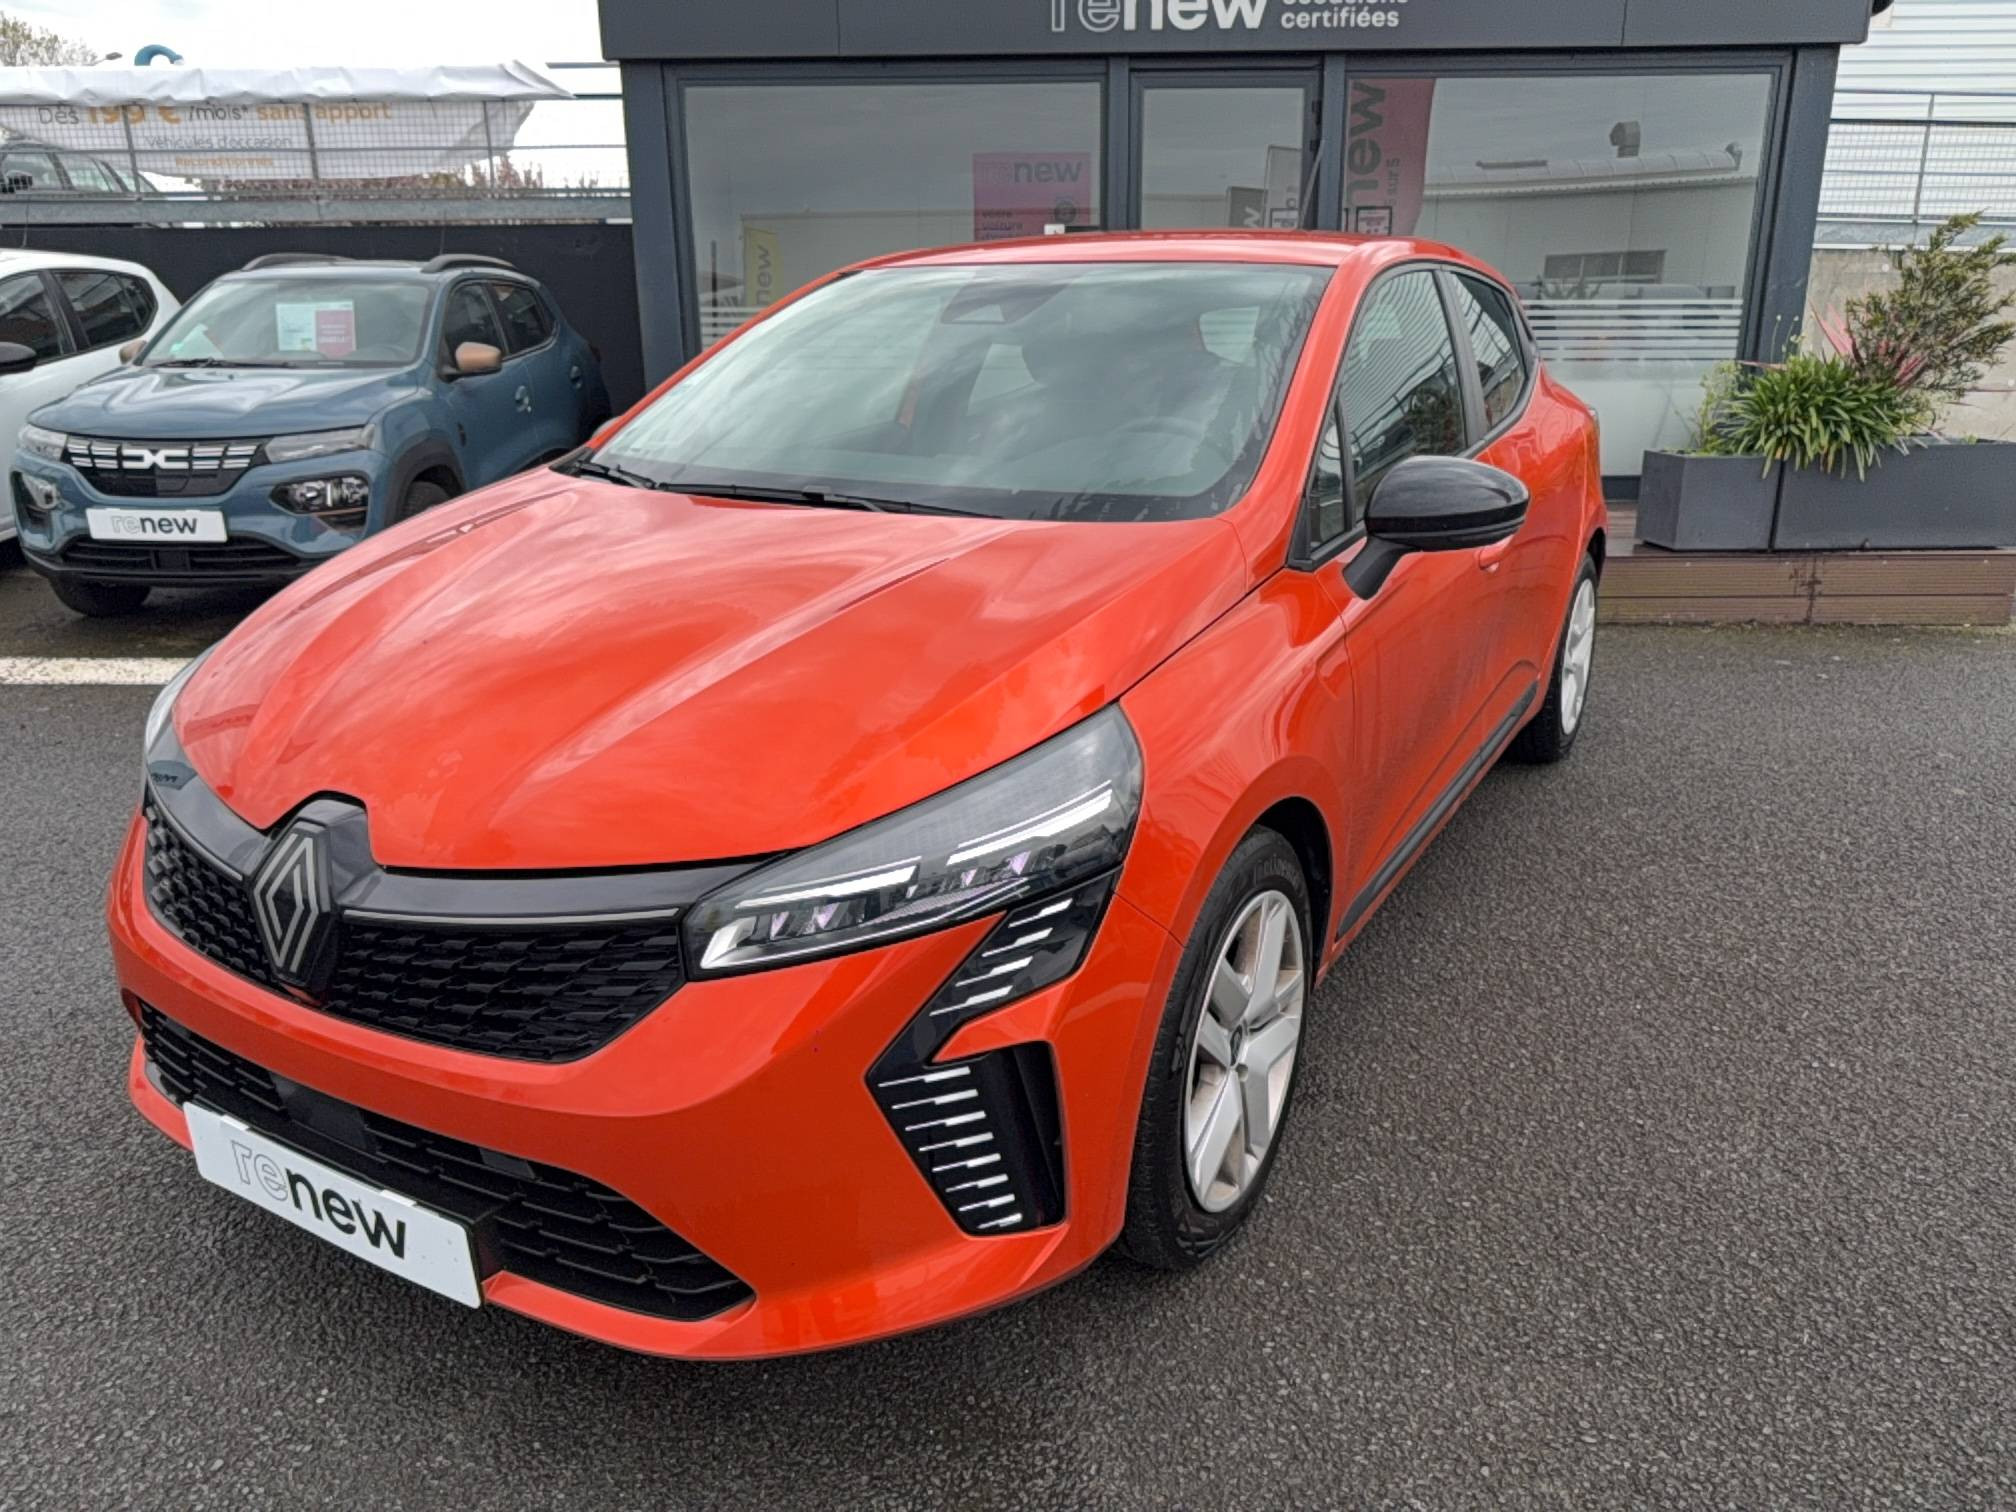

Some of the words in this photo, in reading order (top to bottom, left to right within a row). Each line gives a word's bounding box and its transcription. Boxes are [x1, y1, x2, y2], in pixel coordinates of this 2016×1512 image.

[1280, 5, 1400, 29] certifiées
[315, 103, 392, 124] apport
[110, 514, 198, 535] renew
[230, 1139, 406, 1259] renew
